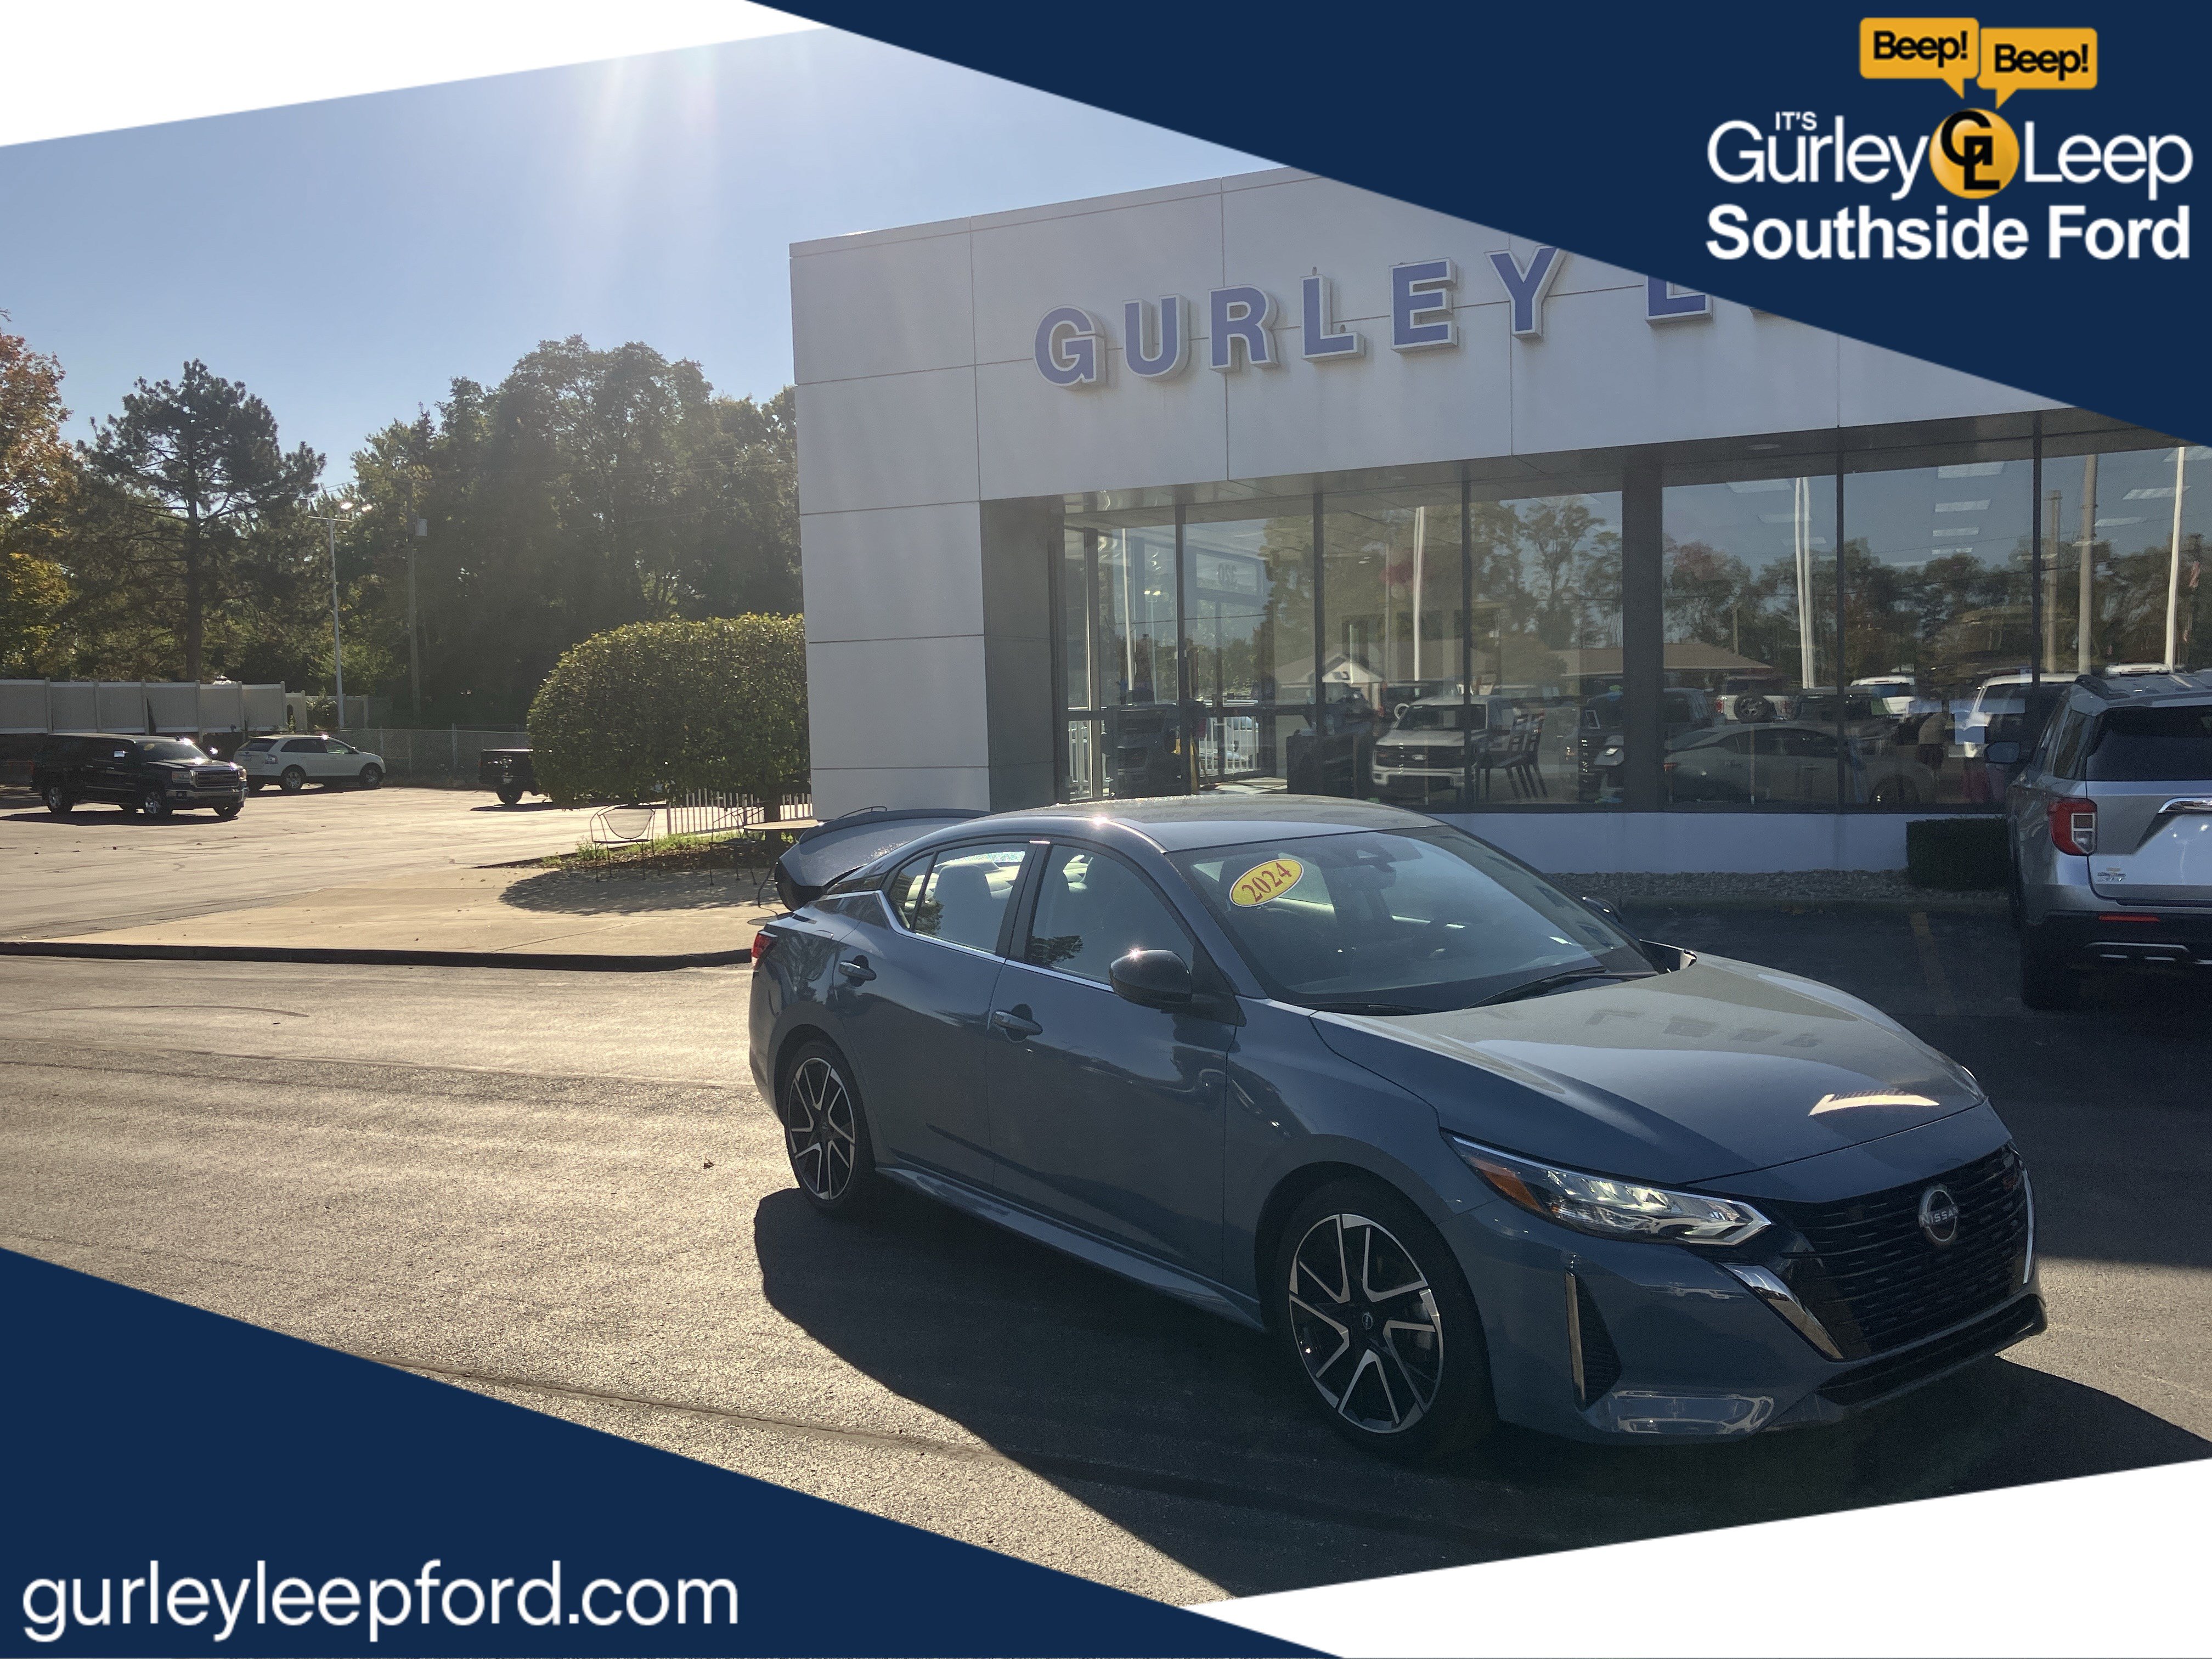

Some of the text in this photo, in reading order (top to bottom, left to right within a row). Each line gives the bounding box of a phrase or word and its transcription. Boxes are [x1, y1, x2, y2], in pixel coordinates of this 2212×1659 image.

[1032, 245, 1564, 388] GURLEY
[1241, 861, 1293, 903] 2024
[1921, 1205, 1959, 1226] NISSAN
